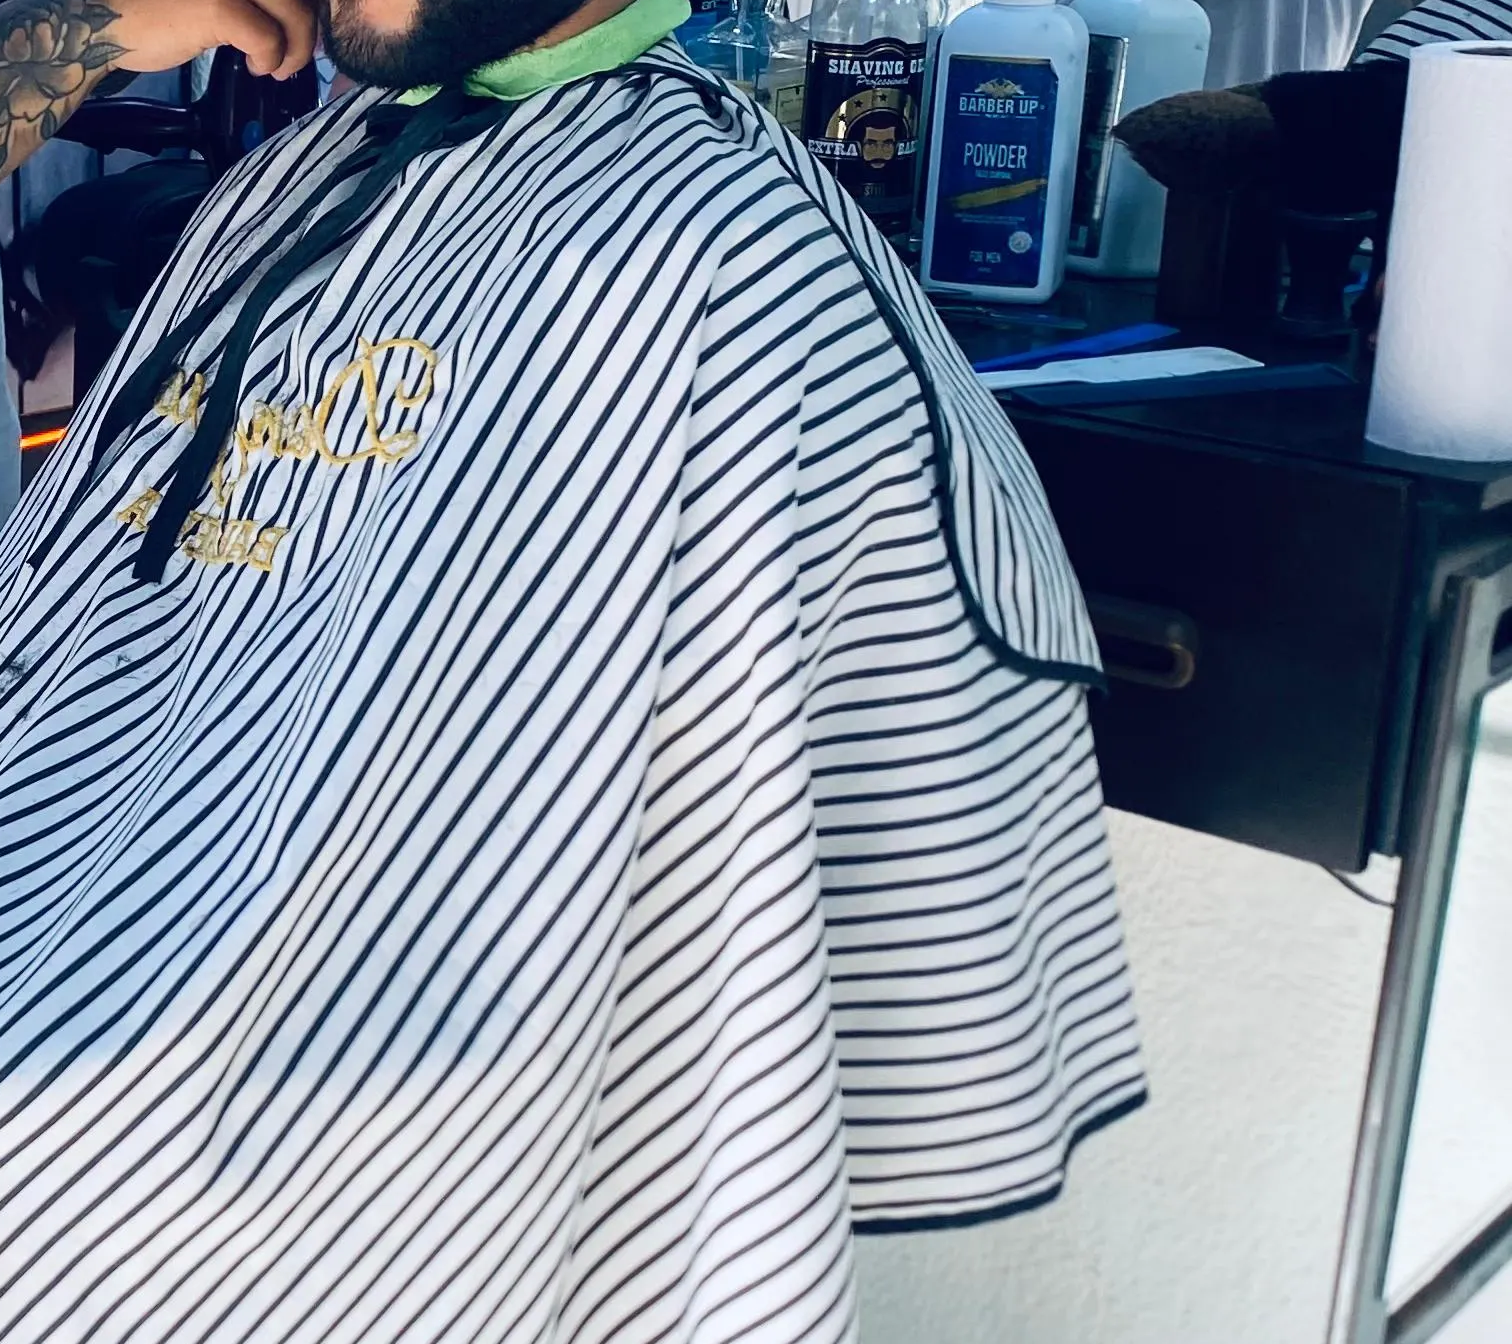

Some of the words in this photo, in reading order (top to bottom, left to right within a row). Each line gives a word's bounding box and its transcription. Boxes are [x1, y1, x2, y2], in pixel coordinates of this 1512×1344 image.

[828, 58, 904, 76] SHAVING
[856, 74, 910, 88] Professional
[959, 97, 1014, 114] BARBER
[1019, 99, 1038, 114] UP
[807, 139, 858, 156] EXTRA
[963, 142, 1028, 169] POWDER
